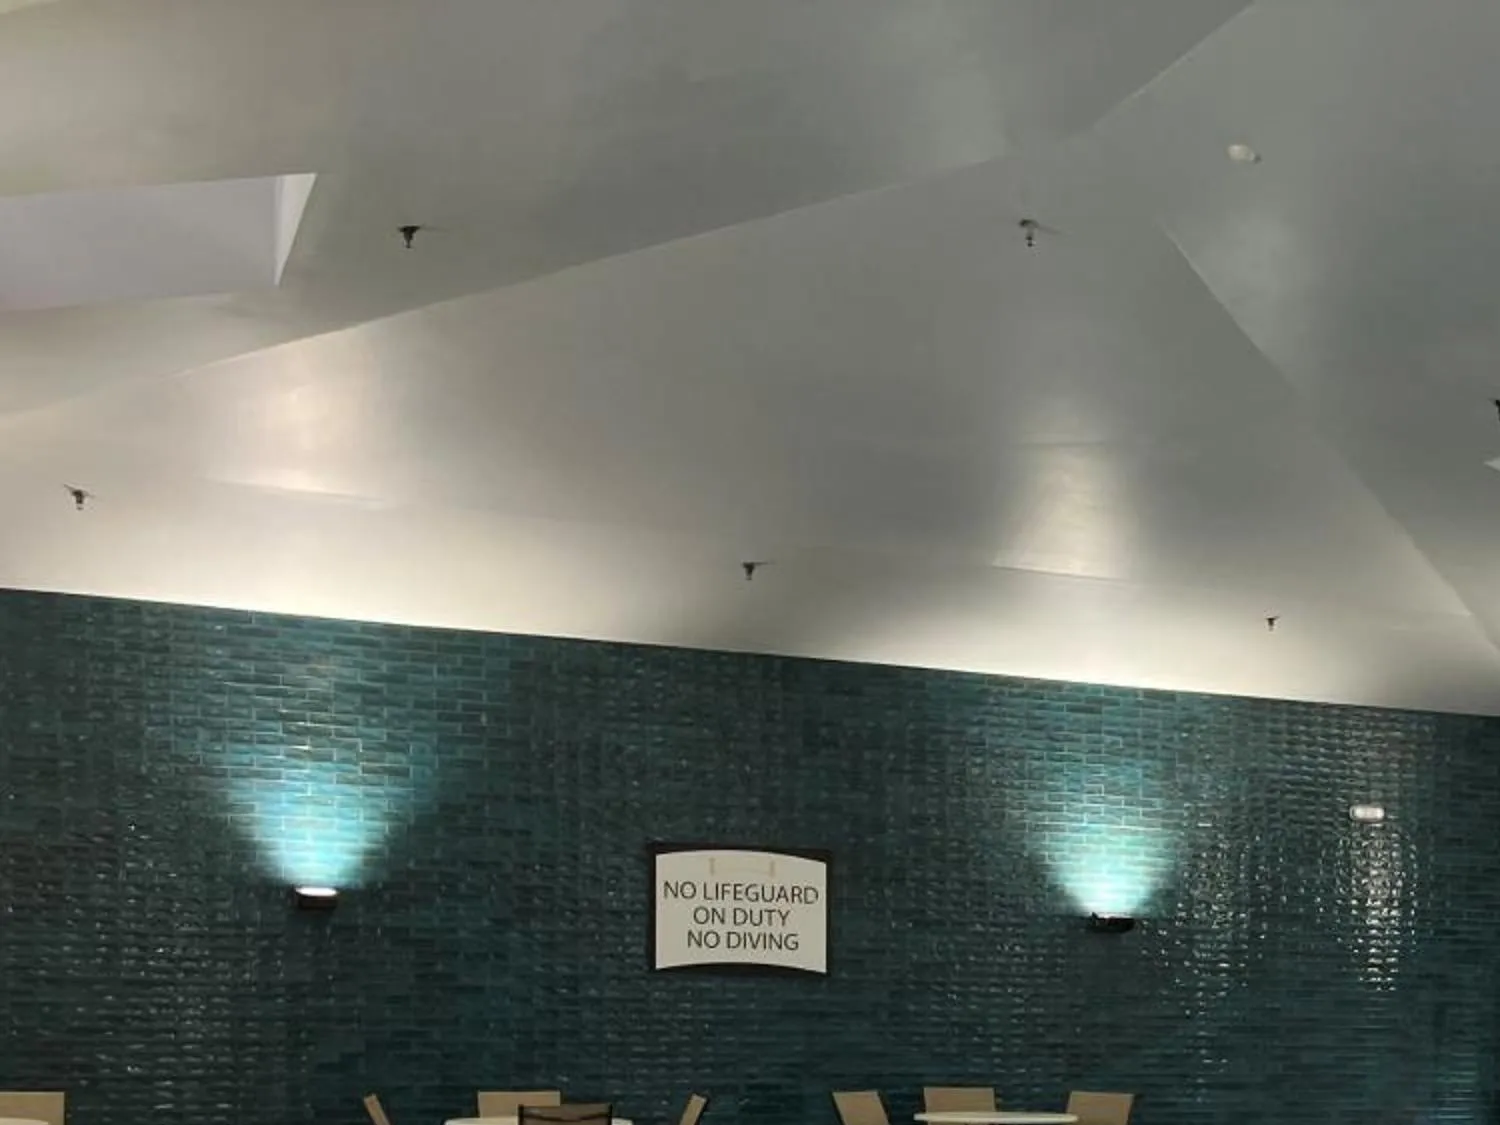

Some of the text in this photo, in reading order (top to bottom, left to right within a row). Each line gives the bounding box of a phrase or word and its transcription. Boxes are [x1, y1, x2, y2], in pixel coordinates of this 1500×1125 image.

[662, 880, 819, 905] NO LIFEGUARD
[692, 906, 791, 927] ON DUTY
[687, 930, 800, 951] NO DIVING
